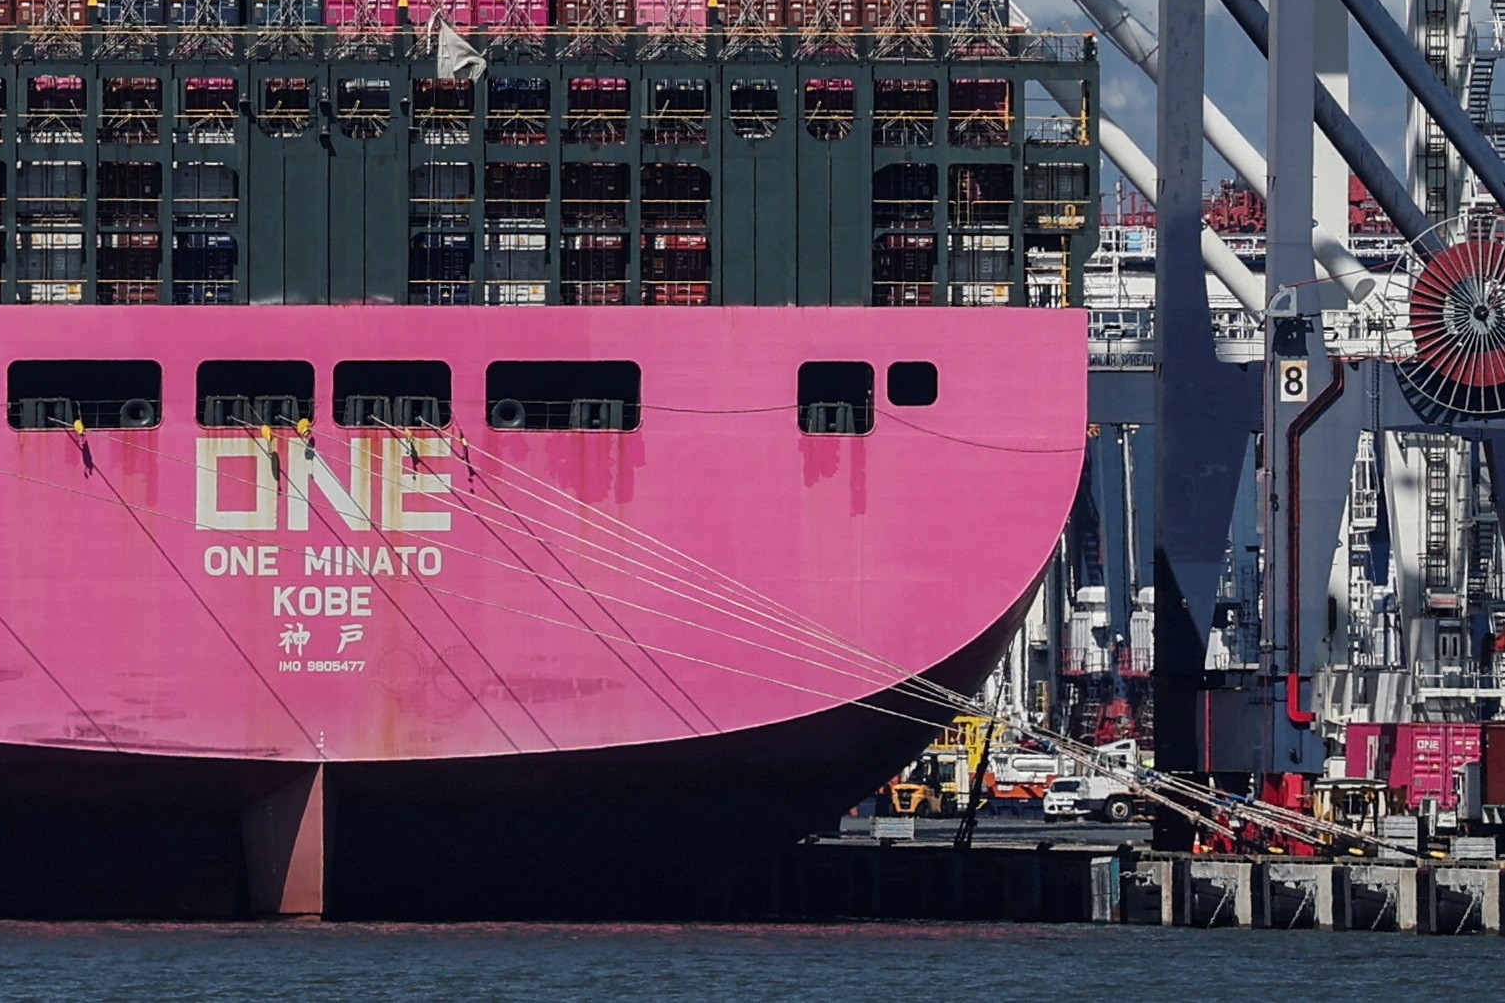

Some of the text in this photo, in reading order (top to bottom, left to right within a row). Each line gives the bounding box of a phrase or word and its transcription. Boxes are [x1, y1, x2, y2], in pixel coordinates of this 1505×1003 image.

[1284, 365, 1302, 395] 8
[195, 437, 452, 531] ONE
[204, 546, 443, 576] ONE MINATO
[273, 586, 372, 616] KOBE
[279, 661, 366, 673] IMO 9805477
[1416, 739, 1439, 749] ONE
